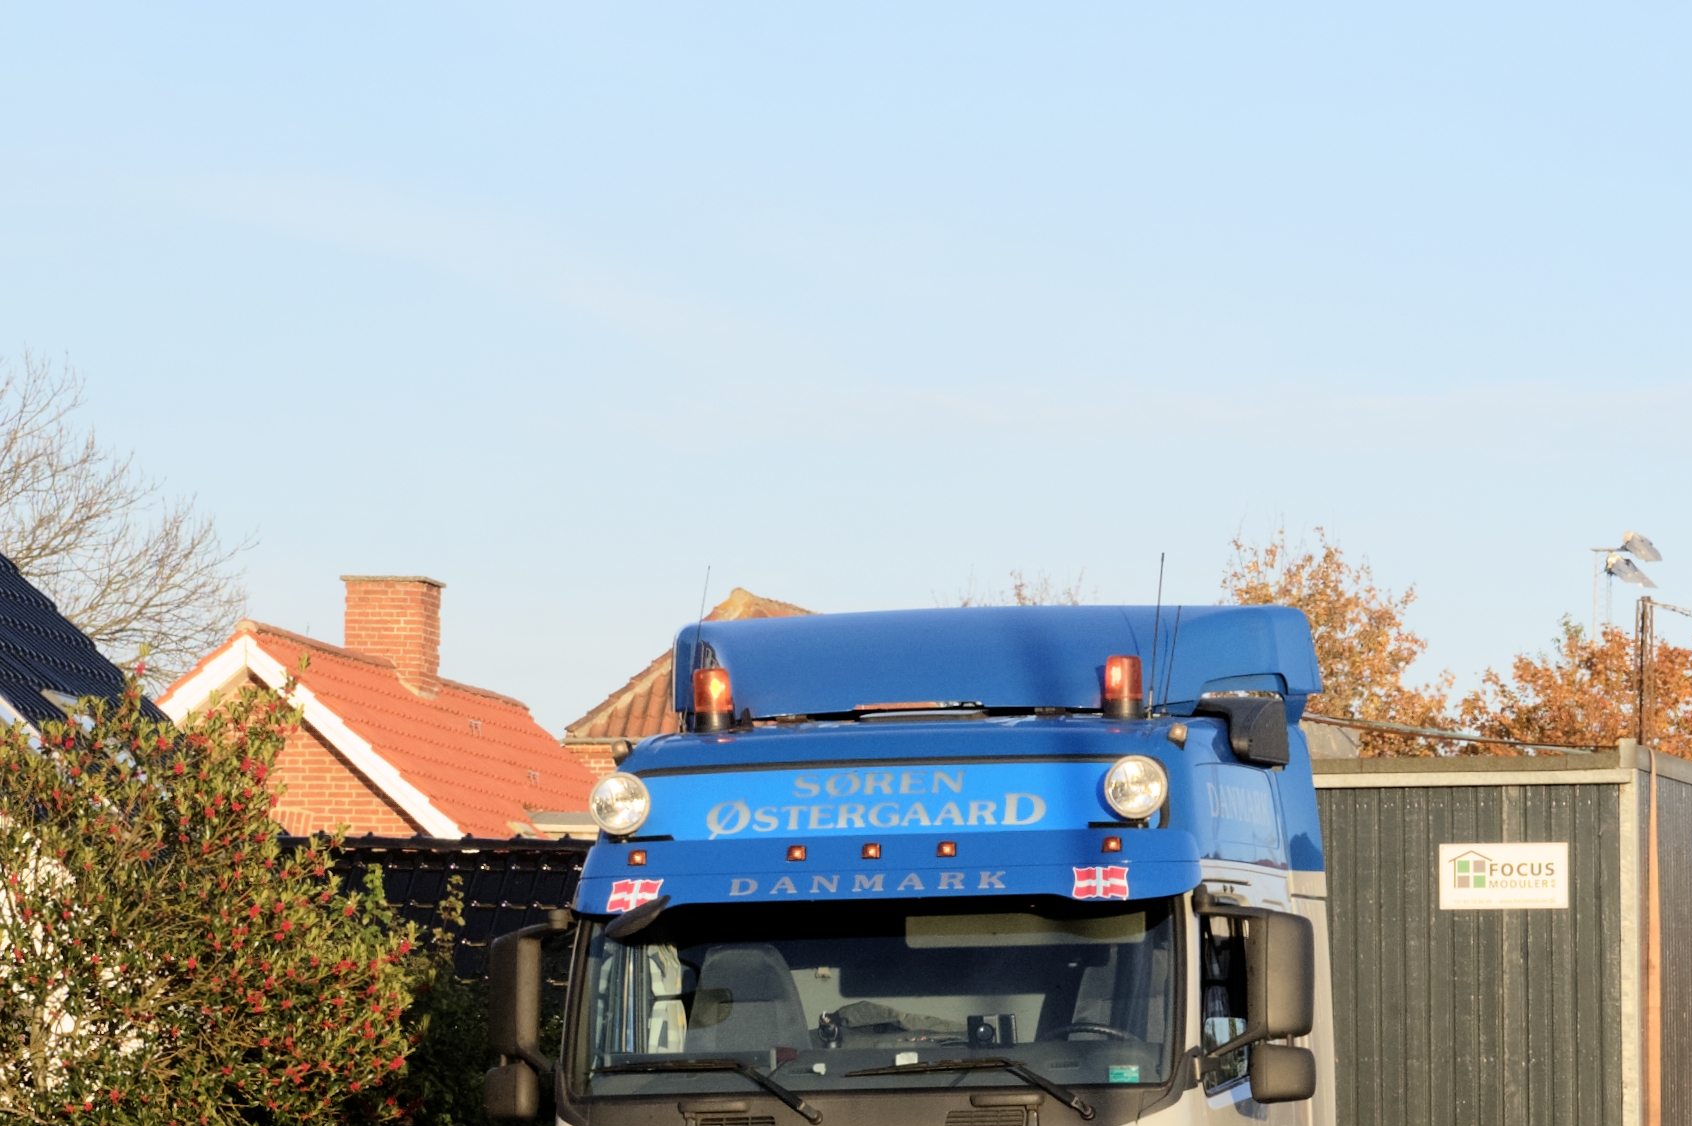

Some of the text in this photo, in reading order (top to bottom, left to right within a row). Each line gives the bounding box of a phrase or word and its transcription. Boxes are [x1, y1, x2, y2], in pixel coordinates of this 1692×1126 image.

[793, 769, 966, 799] SØREN
[706, 792, 1047, 840] ØSTERGAARD
[1489, 862, 1555, 877] FOCUS
[728, 871, 1007, 897] DANMARK
[1488, 879, 1549, 889] MODULER
